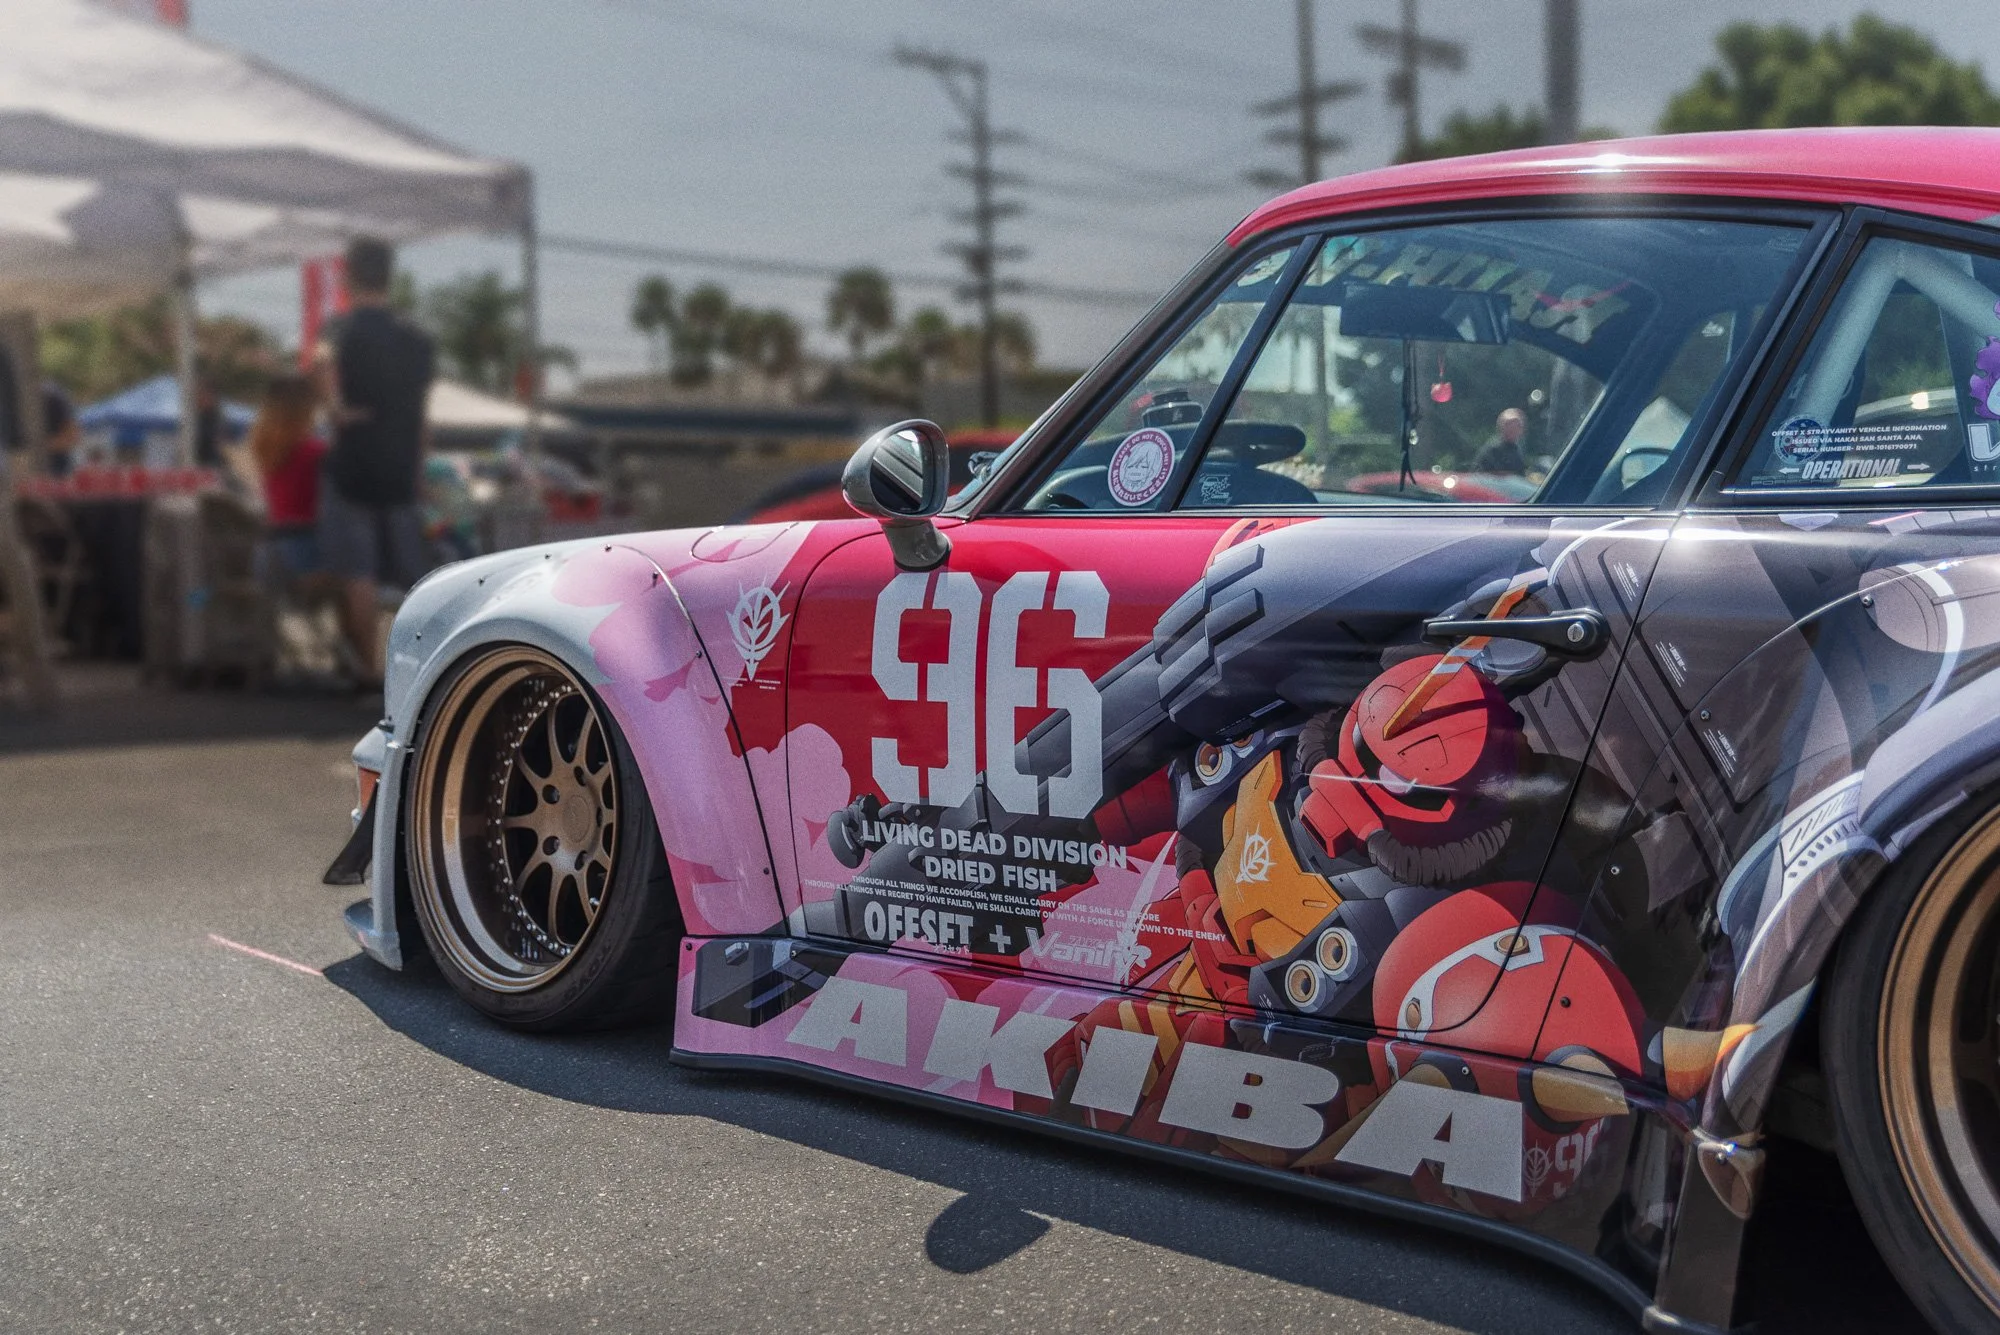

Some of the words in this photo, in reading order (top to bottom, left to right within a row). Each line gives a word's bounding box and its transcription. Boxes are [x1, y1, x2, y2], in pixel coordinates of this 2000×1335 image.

[1892, 424, 1947, 432] INFORMATION
[1115, 443, 1131, 466] PLEASE
[1132, 436, 1140, 444] DO
[1154, 436, 1168, 452] TOUCH
[1801, 458, 1900, 479] OPERATIONAL
[871, 571, 1110, 820] 96
[861, 820, 935, 849] LIVING
[941, 828, 1007, 857] DEAD
[1013, 835, 1127, 869] DIVISION
[924, 855, 996, 885] DRIED
[1003, 864, 1057, 893] FISH
[804, 880, 836, 890] THROUGH
[837, 883, 848, 892] ALL
[850, 884, 874, 895] THINGS
[874, 888, 887, 897] WE
[888, 890, 914, 900] REGRET
[914, 892, 926, 902] TO
[926, 894, 946, 905] HAVE
[946, 898, 974, 910] FAILED,
[975, 901, 989, 911] WE
[990, 904, 1014, 914] SHALL
[1014, 907, 1041, 918] CARRY
[1042, 910, 1055, 920] ON
[1056, 912, 1078, 923] WITH
[1088, 916, 1114, 928] FORCE
[1162, 926, 1174, 935] TO
[1176, 928, 1194, 938] THE
[1195, 930, 1226, 942] ENEMY
[852, 875, 885, 887] THROUGH
[886, 879, 898, 888] ALL
[900, 881, 925, 892] THINGS
[926, 884, 938, 894] WE
[940, 886, 989, 901] ACCOMPLISH,
[990, 894, 1003, 902] WE
[1004, 894, 1029, 906] SHALL
[1030, 898, 1057, 909] CARRY
[1058, 901, 1070, 910] ON
[1072, 903, 1088, 913] THE
[1088, 906, 1112, 916] SAME
[1114, 908, 1124, 918] AS
[785, 975, 1523, 1202] AKIBA
